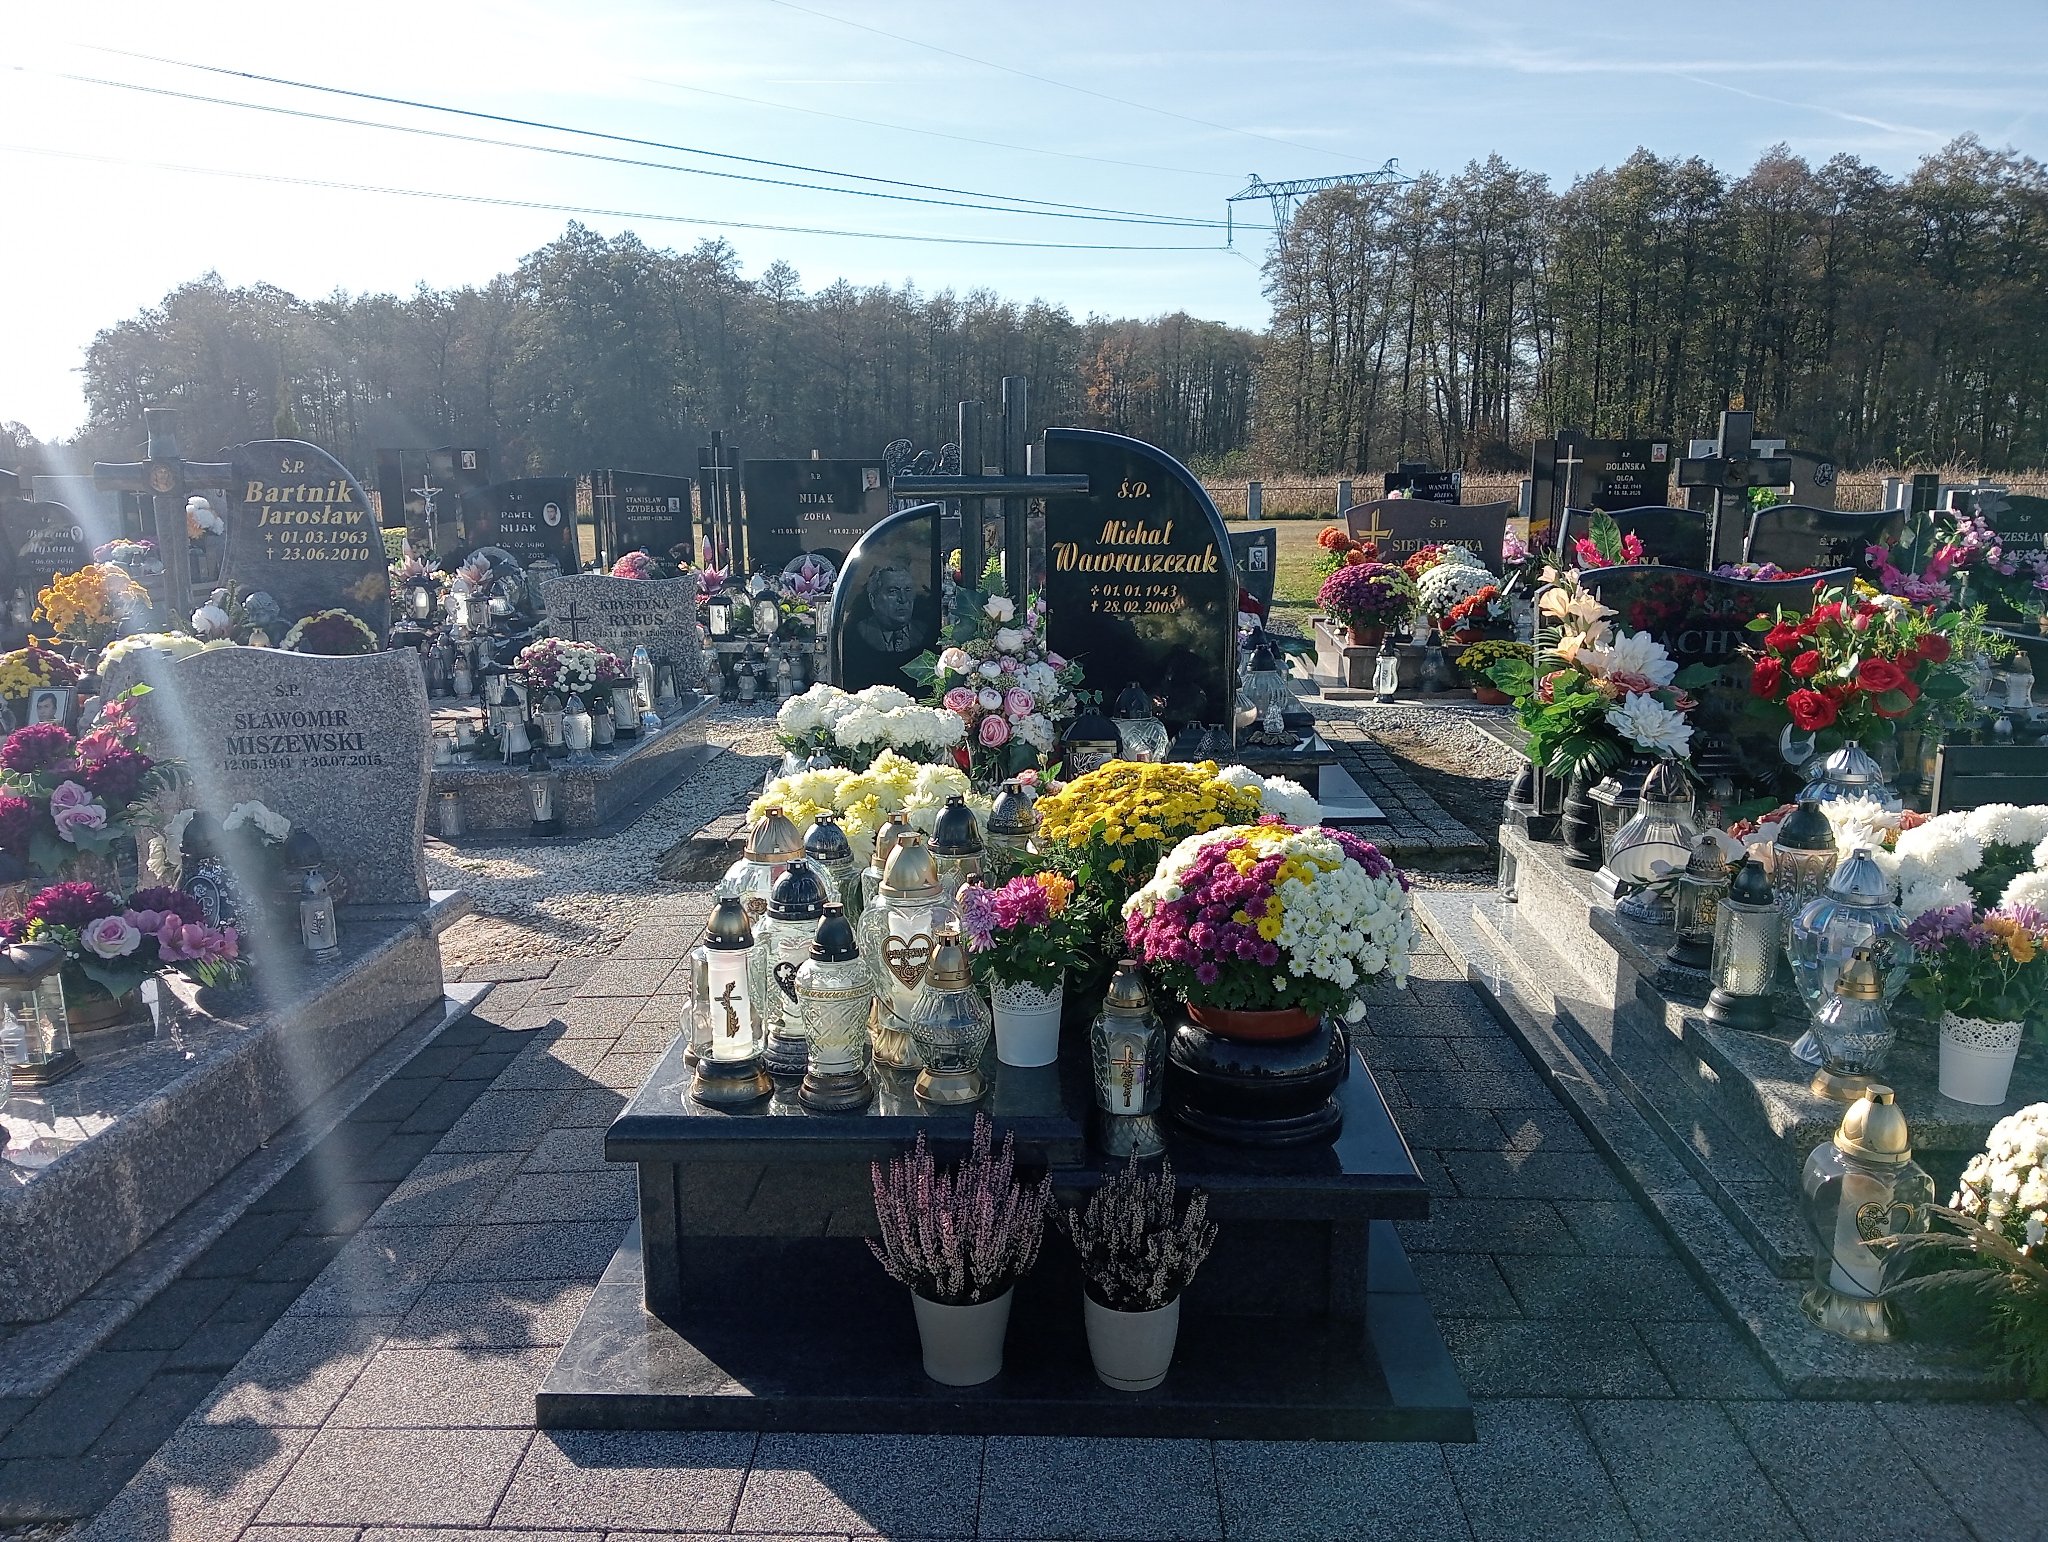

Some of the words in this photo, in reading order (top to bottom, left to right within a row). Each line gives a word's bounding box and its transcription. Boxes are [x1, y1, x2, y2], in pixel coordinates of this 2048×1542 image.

[280, 457, 305, 474] Ś.P.
[243, 479, 354, 503] Bartnik
[1117, 477, 1151, 499] Ś.P.
[799, 493, 835, 504] NIJAK
[257, 504, 365, 528] Jarosław
[501, 511, 534, 520] PAWEŁ
[626, 505, 667, 513] SZYDEŁKO
[803, 512, 832, 521] ZOFIA
[1429, 516, 1448, 528] Ś.P.
[500, 524, 537, 533] NIJAK
[1095, 519, 1175, 546] Michał
[280, 530, 368, 544] 01.03.1963
[281, 547, 370, 561] 23.06.2010
[1051, 542, 1218, 573] Wawruszczak
[599, 599, 670, 610] KRYSTYNA
[608, 613, 664, 626] RYBUS
[234, 709, 350, 730] SŁAWOMIR
[227, 732, 365, 755] MISZEWSKI
[223, 757, 292, 771] 12.05.1941
[311, 755, 382, 768] 30.07.2015
